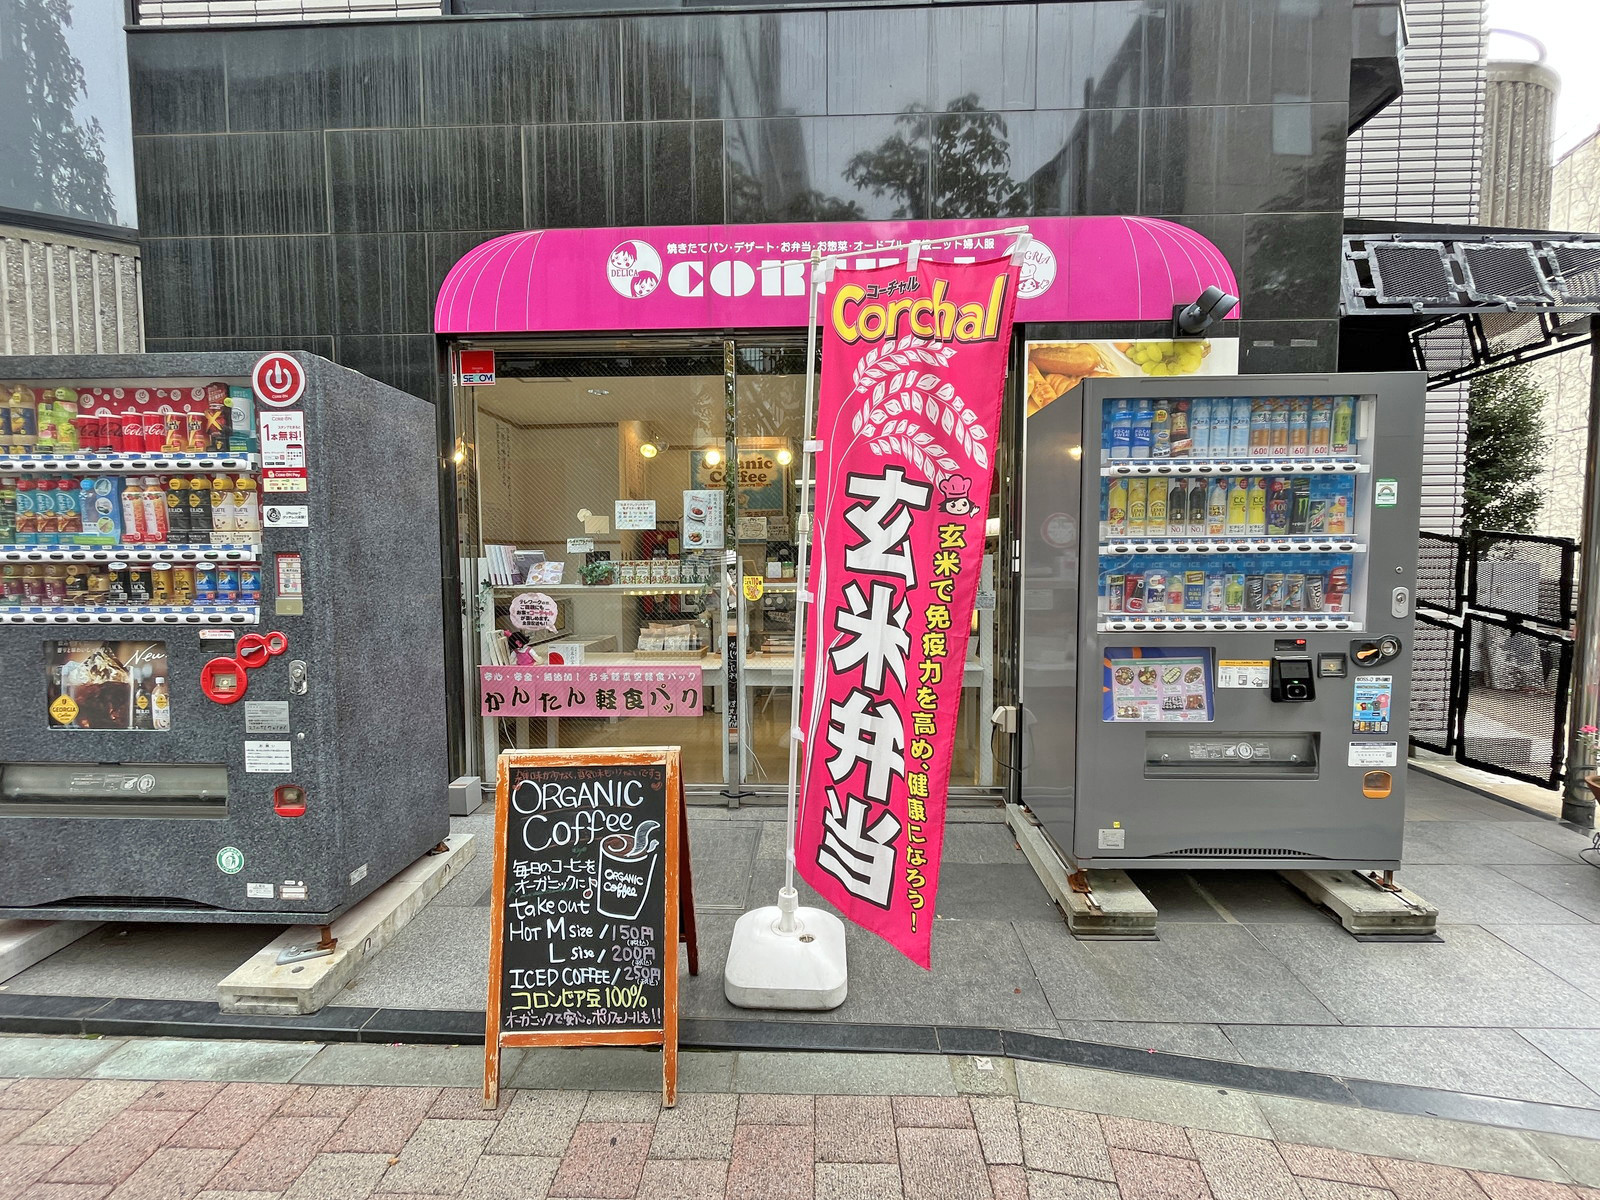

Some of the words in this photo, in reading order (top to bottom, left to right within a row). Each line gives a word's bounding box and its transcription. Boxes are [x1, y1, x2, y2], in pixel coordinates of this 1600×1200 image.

[611, 268, 639, 278] DELICA
[866, 276, 921, 299] コーチャル
[832, 273, 1010, 345] Corchal
[463, 374, 493, 383] SECOM
[816, 465, 933, 910] 玄米弁当
[512, 779, 644, 815] ORGANIC
[522, 809, 634, 851] Coffee
[512, 858, 597, 880] 毎日のコーヒーを
[604, 869, 644, 886] ORGANIC
[508, 897, 556, 920] take
[557, 900, 590, 914] out
[546, 916, 566, 940] M
[569, 924, 594, 938] size
[549, 943, 566, 964] L
[509, 968, 559, 989] ICED
[562, 967, 610, 985] COFFEE
[511, 987, 601, 1010] コロンビア豆
[605, 984, 647, 1008] 100%
